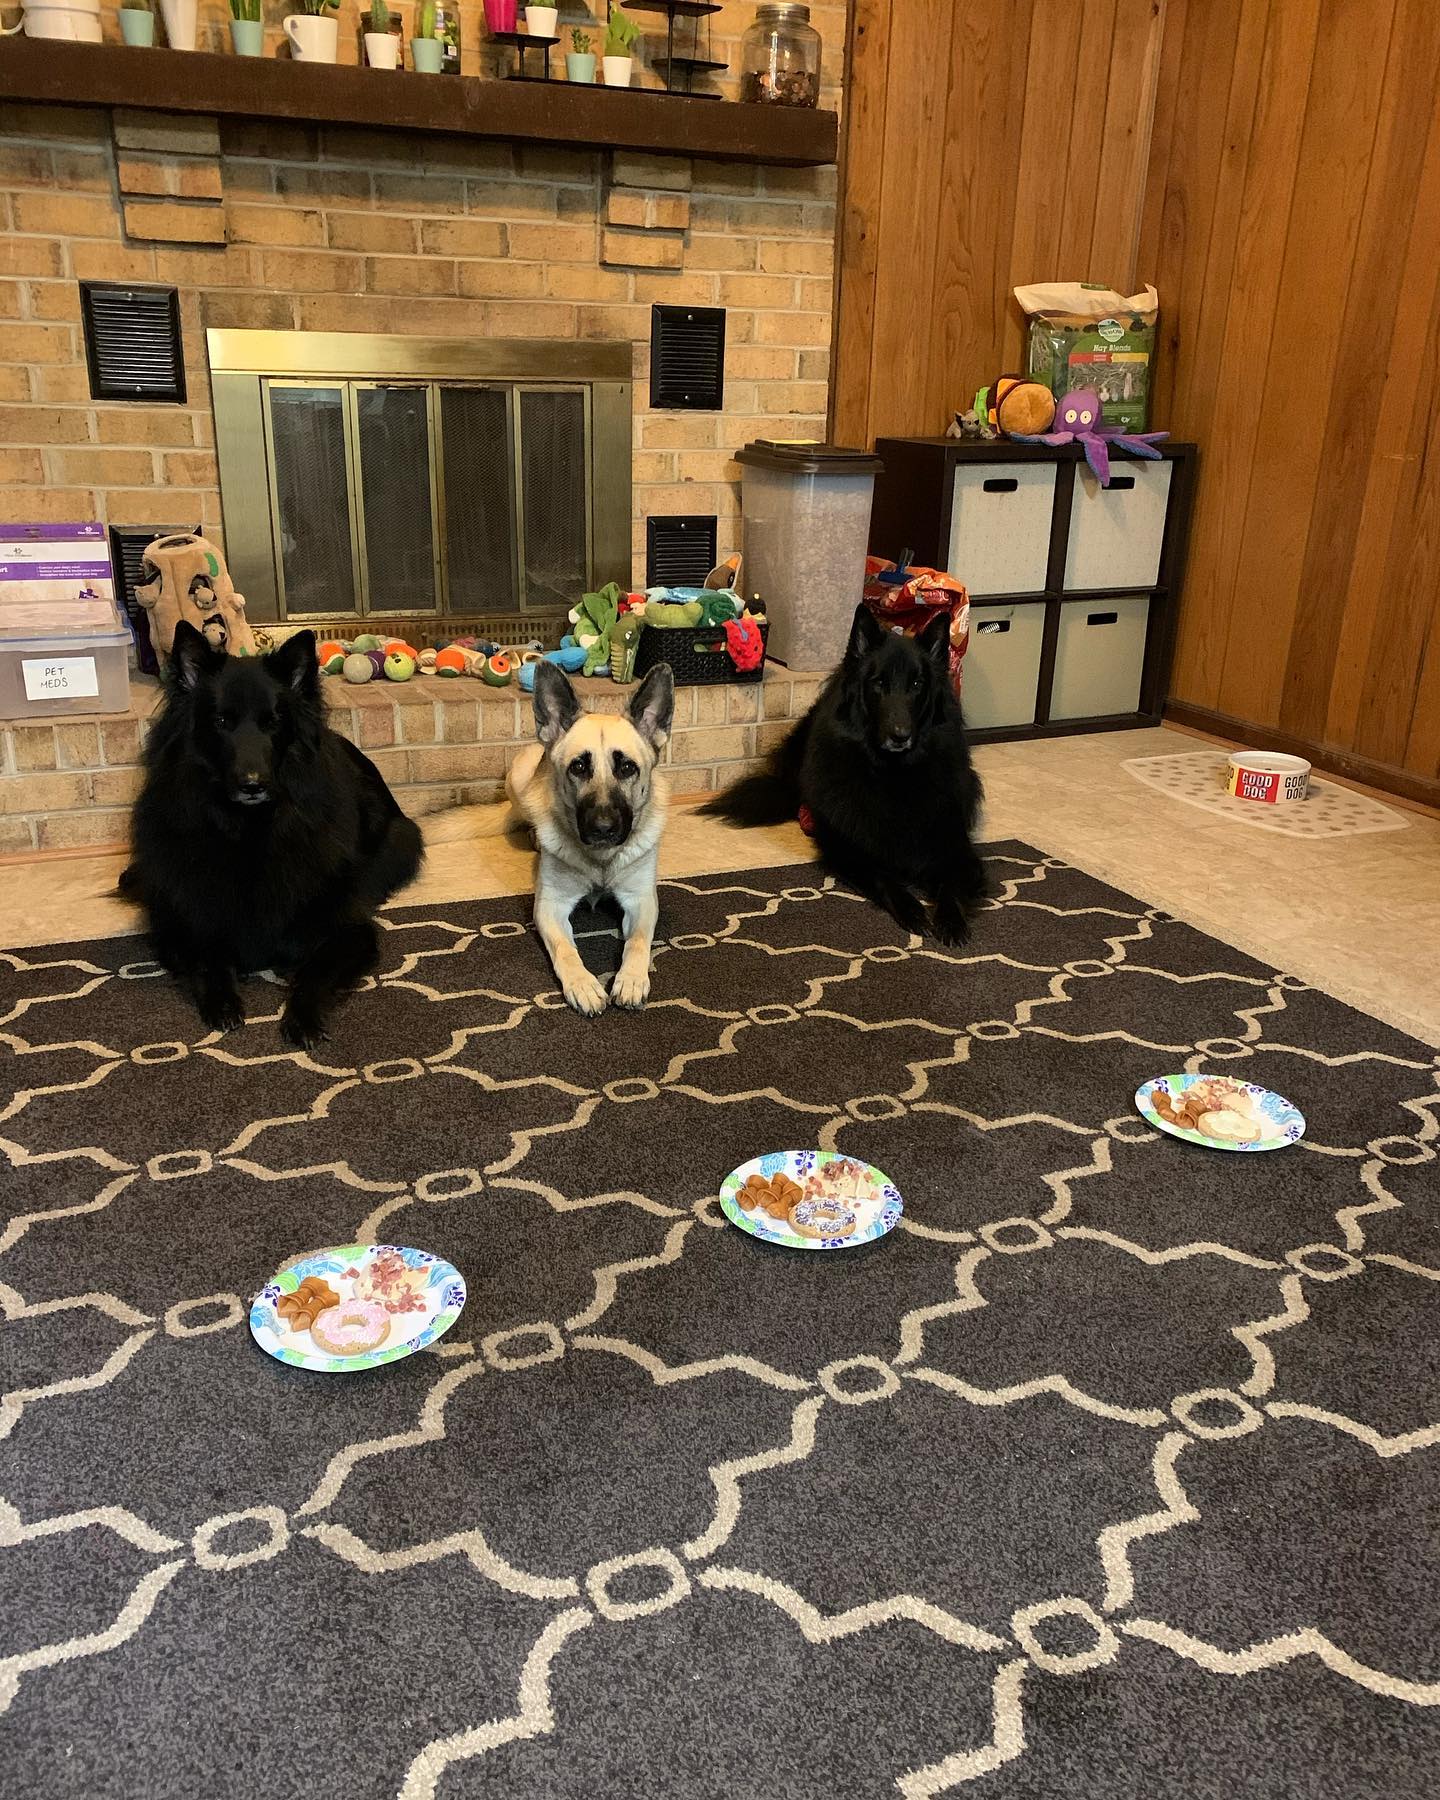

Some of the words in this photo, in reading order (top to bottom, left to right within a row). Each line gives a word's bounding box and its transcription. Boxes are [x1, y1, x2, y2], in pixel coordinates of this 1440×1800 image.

[1093, 344, 1107, 353] Hay
[1109, 344, 1131, 352] Blends
[45, 667, 65, 676] PET
[40, 677, 68, 689] MEDS
[1242, 772, 1273, 788] GOOD
[1243, 785, 1267, 800] DOG
[1286, 787, 1303, 800] DOG
